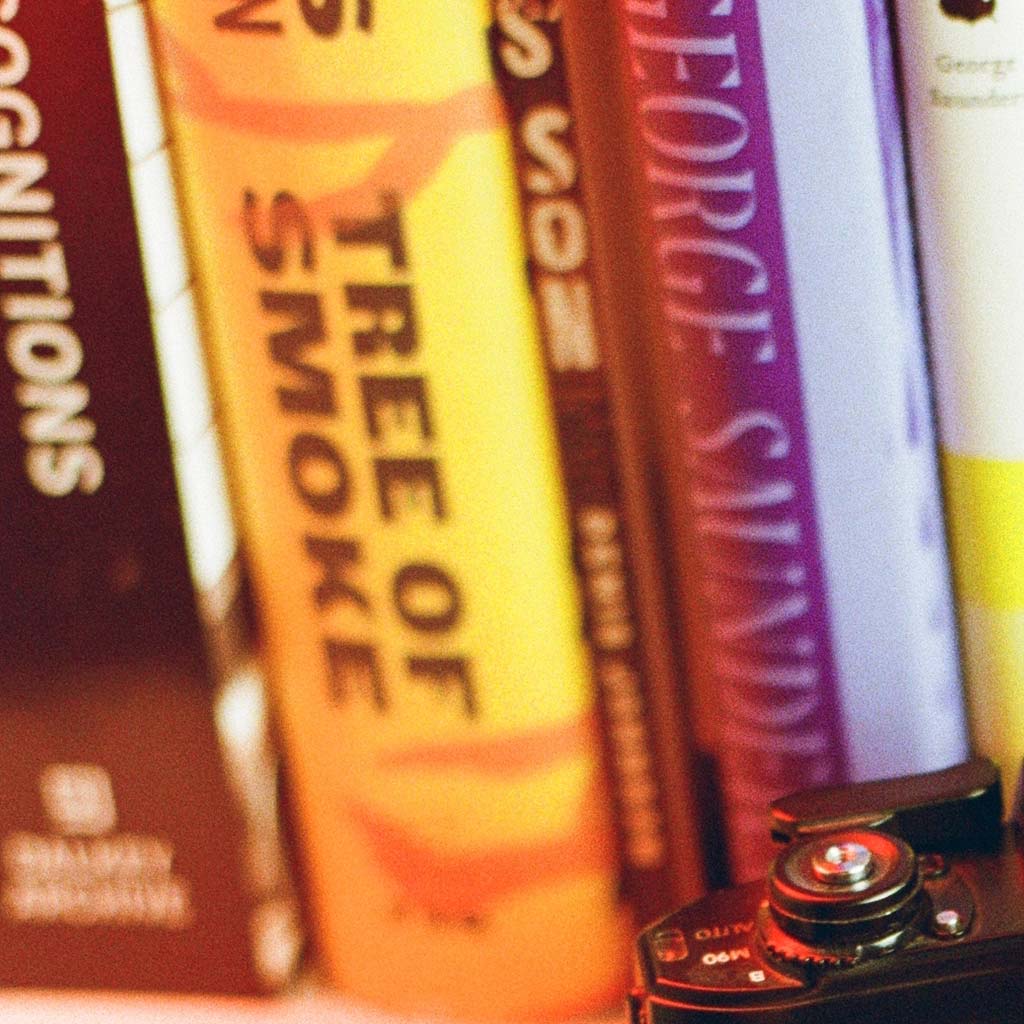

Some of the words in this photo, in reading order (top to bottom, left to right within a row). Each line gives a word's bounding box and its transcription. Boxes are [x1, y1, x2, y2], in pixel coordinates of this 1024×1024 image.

[0, 0, 104, 497] GNITIONS
[240, 187, 388, 712] SMOKE
[332, 190, 452, 523] TREE
[388, 560, 477, 721] OF
